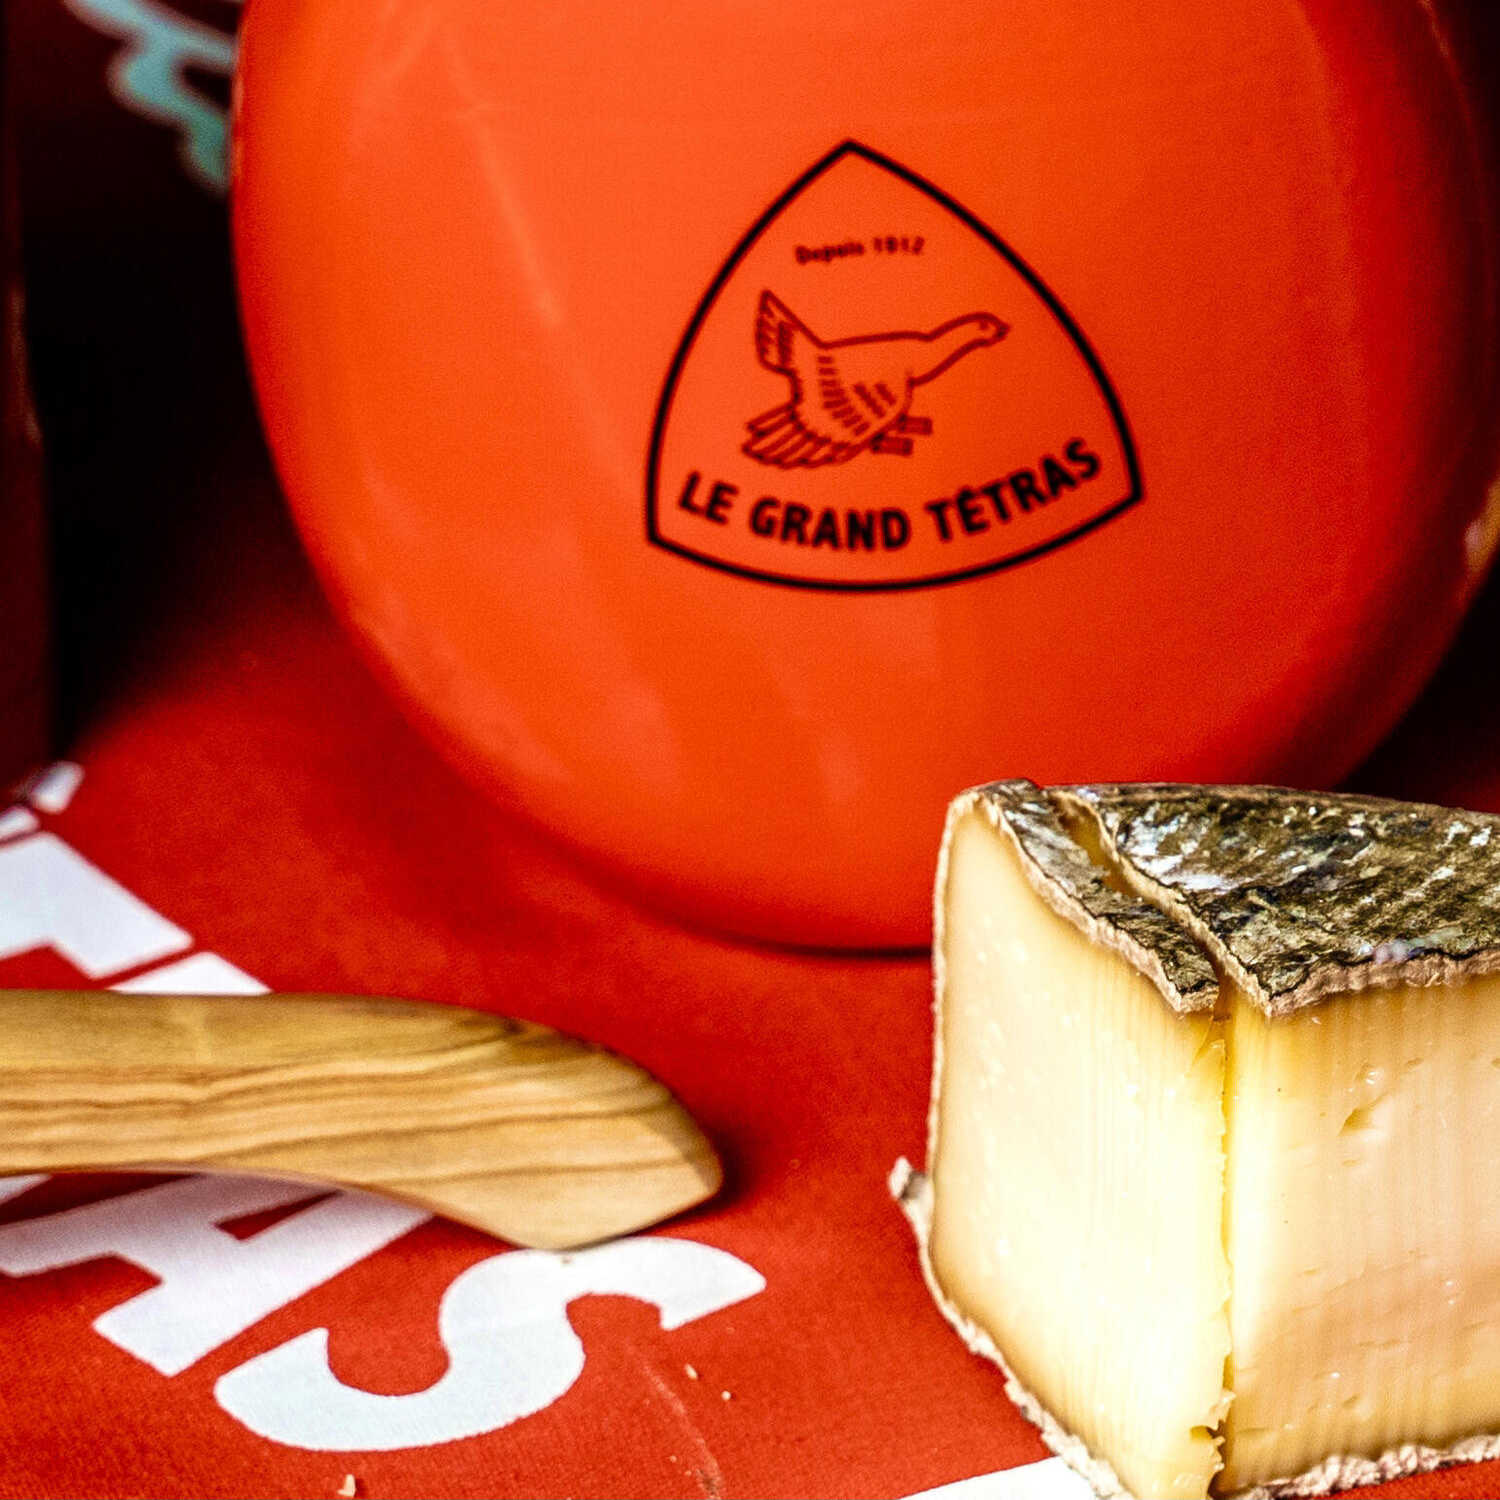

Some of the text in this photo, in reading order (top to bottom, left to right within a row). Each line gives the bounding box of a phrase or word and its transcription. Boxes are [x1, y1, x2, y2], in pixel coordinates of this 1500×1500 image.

[795, 235, 926, 265] Depuis 1912
[678, 437, 1102, 553] LE GRAND TÉTRAS
